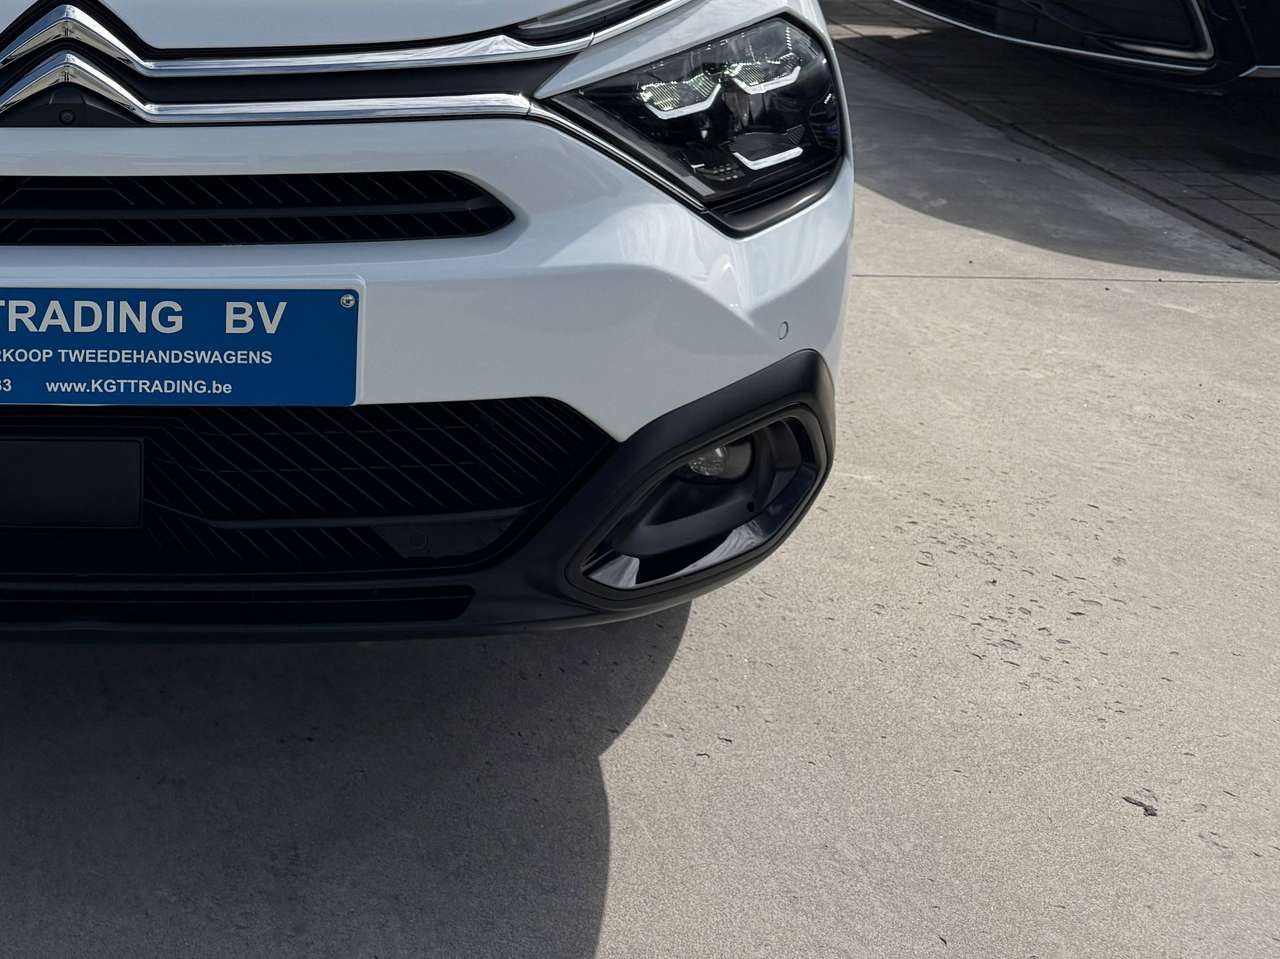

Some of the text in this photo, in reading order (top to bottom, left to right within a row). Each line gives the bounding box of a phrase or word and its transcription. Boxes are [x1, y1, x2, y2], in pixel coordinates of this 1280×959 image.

[225, 301, 288, 335] BV
[57, 349, 273, 365] TWEEDEHANDSWAGENS
[45, 378, 233, 394] www.KGTTRADING.be
